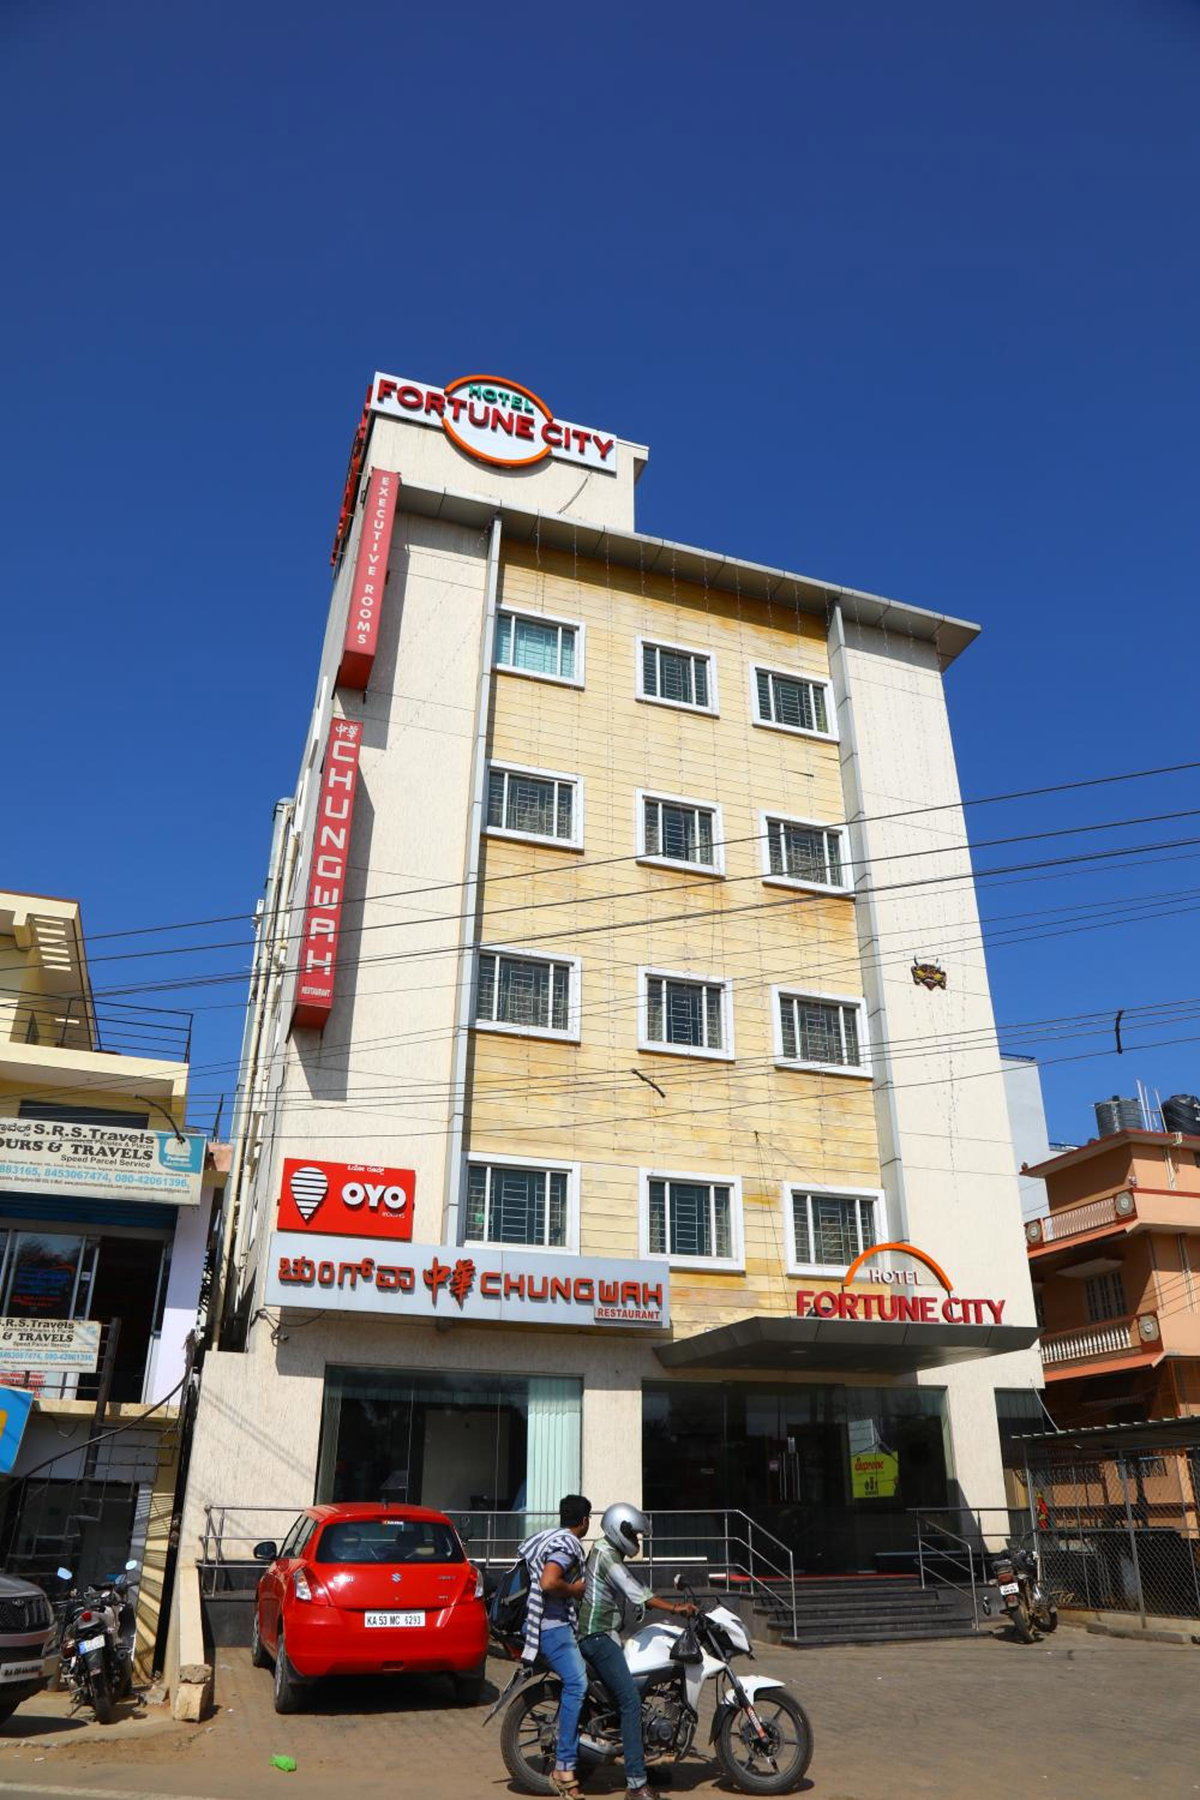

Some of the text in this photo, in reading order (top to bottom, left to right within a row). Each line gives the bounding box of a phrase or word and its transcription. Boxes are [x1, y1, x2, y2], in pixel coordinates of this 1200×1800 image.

[468, 384, 535, 414] HOTEL
[377, 378, 614, 460] FORTUNE CITY
[357, 476, 389, 645] EXECUTIVE ROOMS
[47, 1141, 63, 1153] &
[71, 1144, 154, 1161] TRAVELS
[60, 1154, 88, 1164] Speed
[90, 1156, 117, 1166] Parcel
[119, 1159, 151, 1169] Service
[341, 1181, 407, 1210] OYO
[423, 1255, 476, 1311] 中華
[869, 1268, 922, 1286] HOTEL
[597, 1307, 661, 1320] RESTAURANT
[796, 1289, 1006, 1325] FORTUNE CITY
[0, 1318, 74, 1331] .R.S.Travels
[2, 1332, 74, 1343] & TRAVELS
[367, 1615, 377, 1626] KA
[379, 1615, 387, 1626] 53
